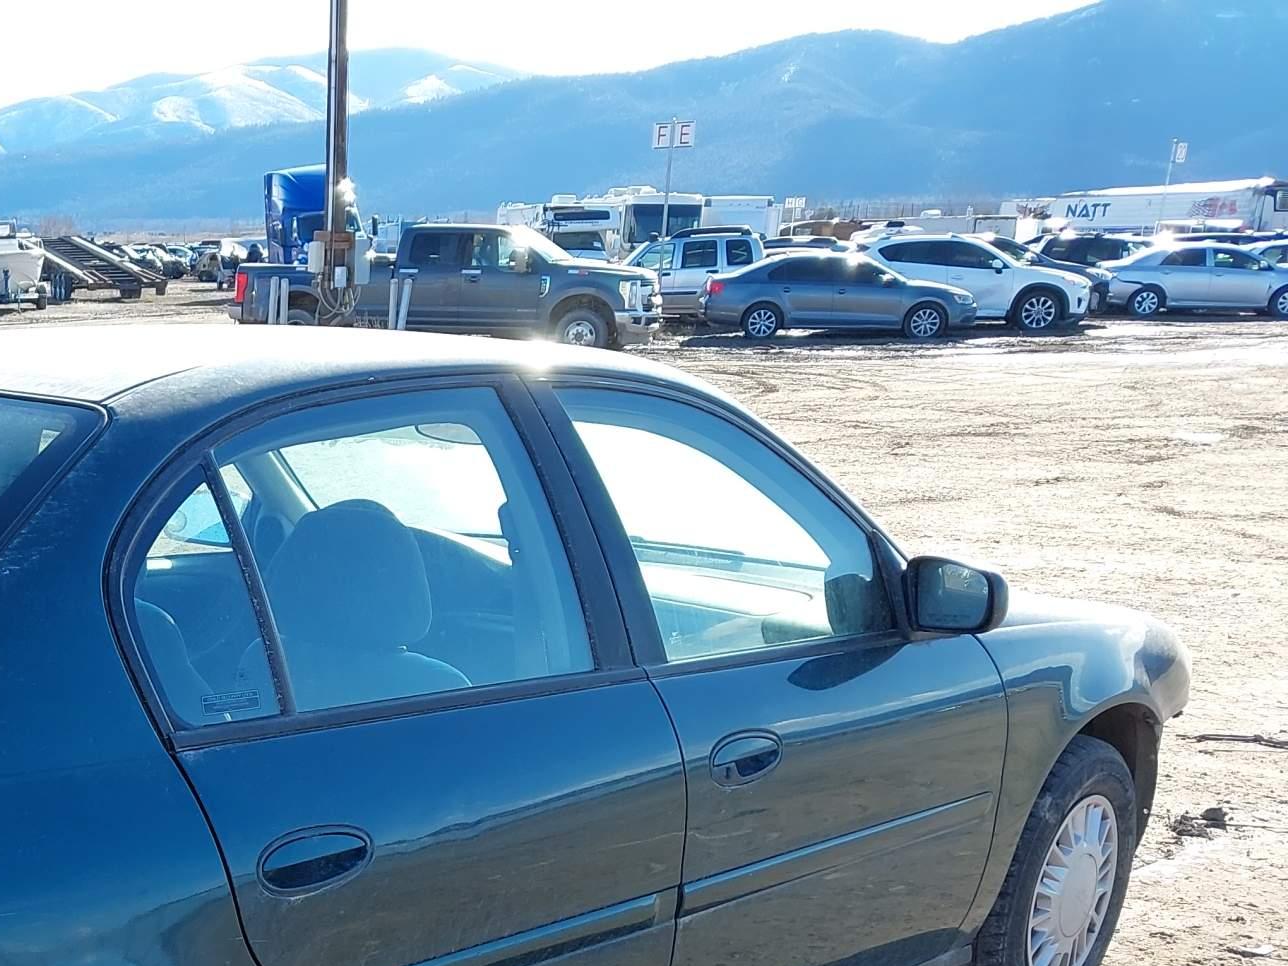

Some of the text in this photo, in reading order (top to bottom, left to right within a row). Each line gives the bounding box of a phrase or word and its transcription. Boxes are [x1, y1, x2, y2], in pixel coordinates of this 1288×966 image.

[657, 124, 691, 146] F E
[1065, 203, 1112, 221] NATT
